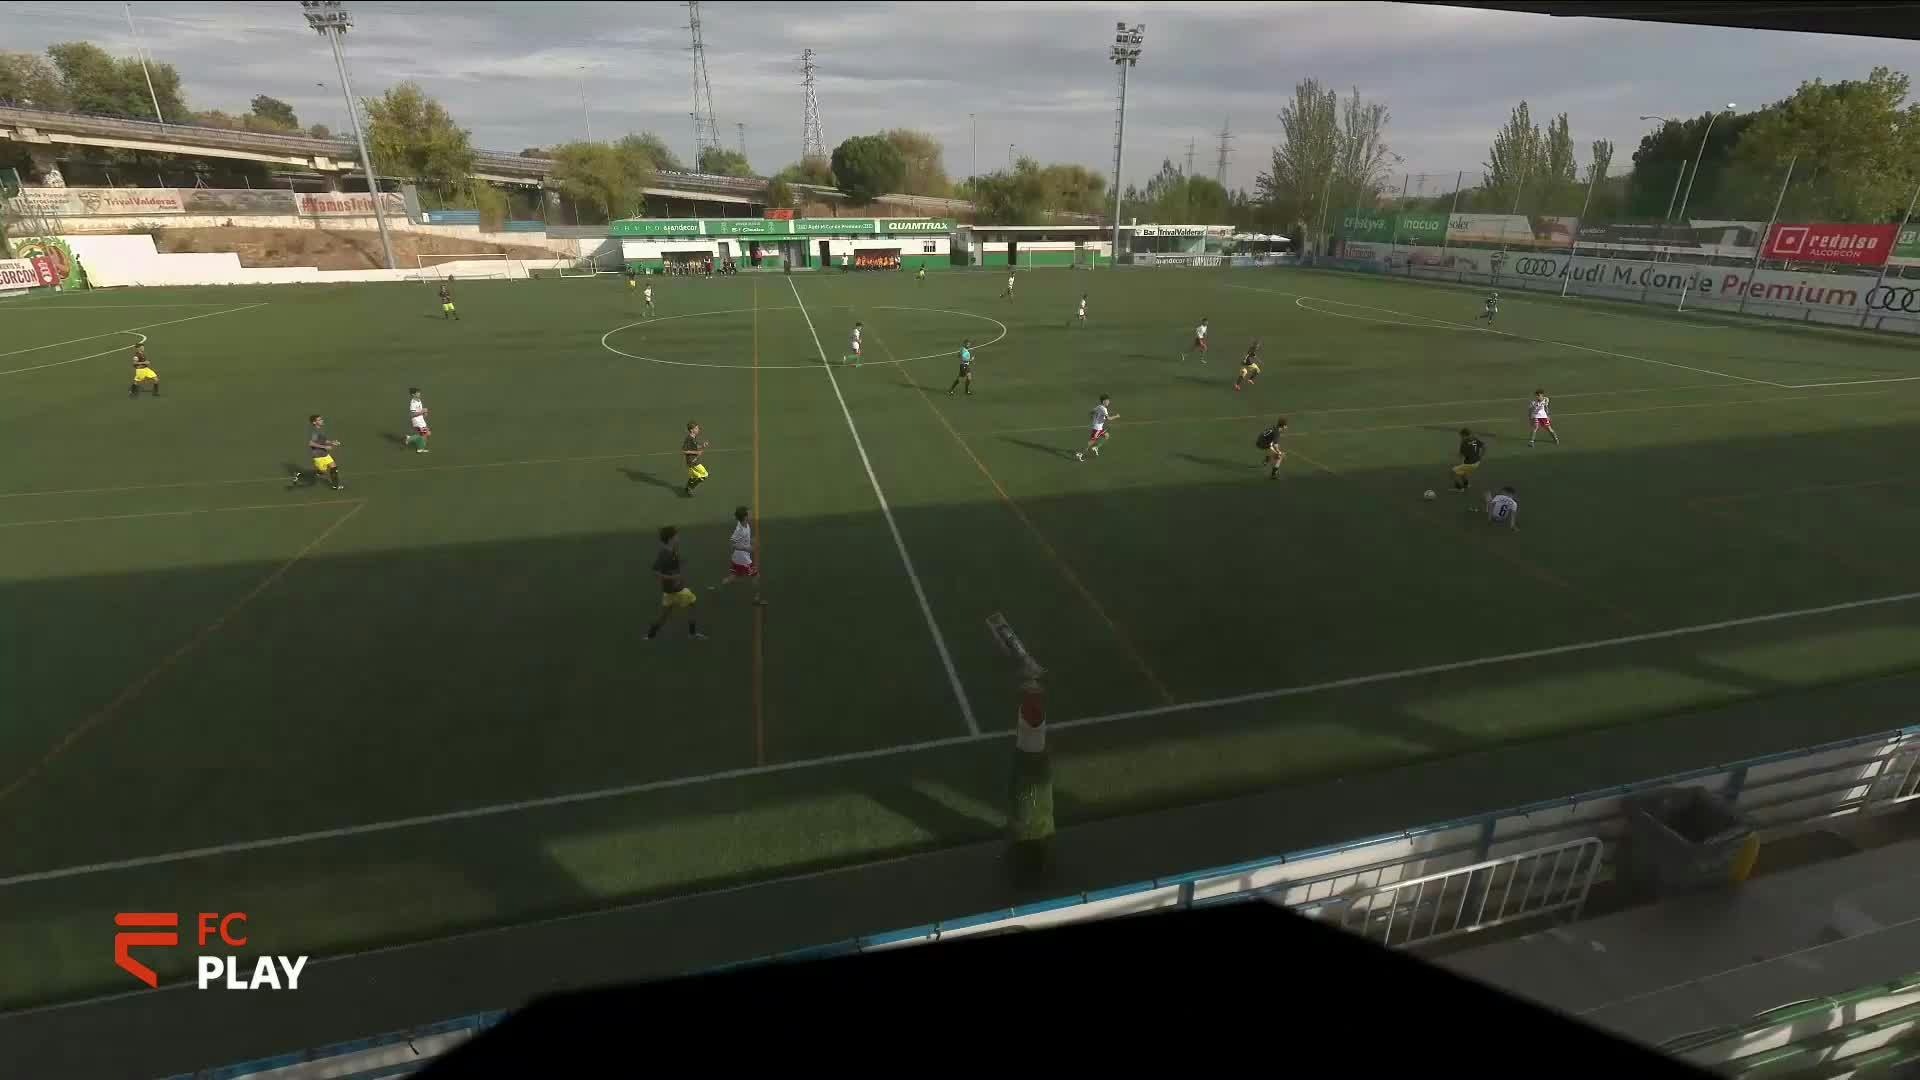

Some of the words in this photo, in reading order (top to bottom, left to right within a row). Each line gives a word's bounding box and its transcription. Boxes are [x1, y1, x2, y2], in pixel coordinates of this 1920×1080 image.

[888, 222, 948, 230] QUAMTRAX
[1808, 233, 1879, 250] redpiso
[1558, 263, 1606, 284] Audi
[1719, 273, 1857, 307] Premium
